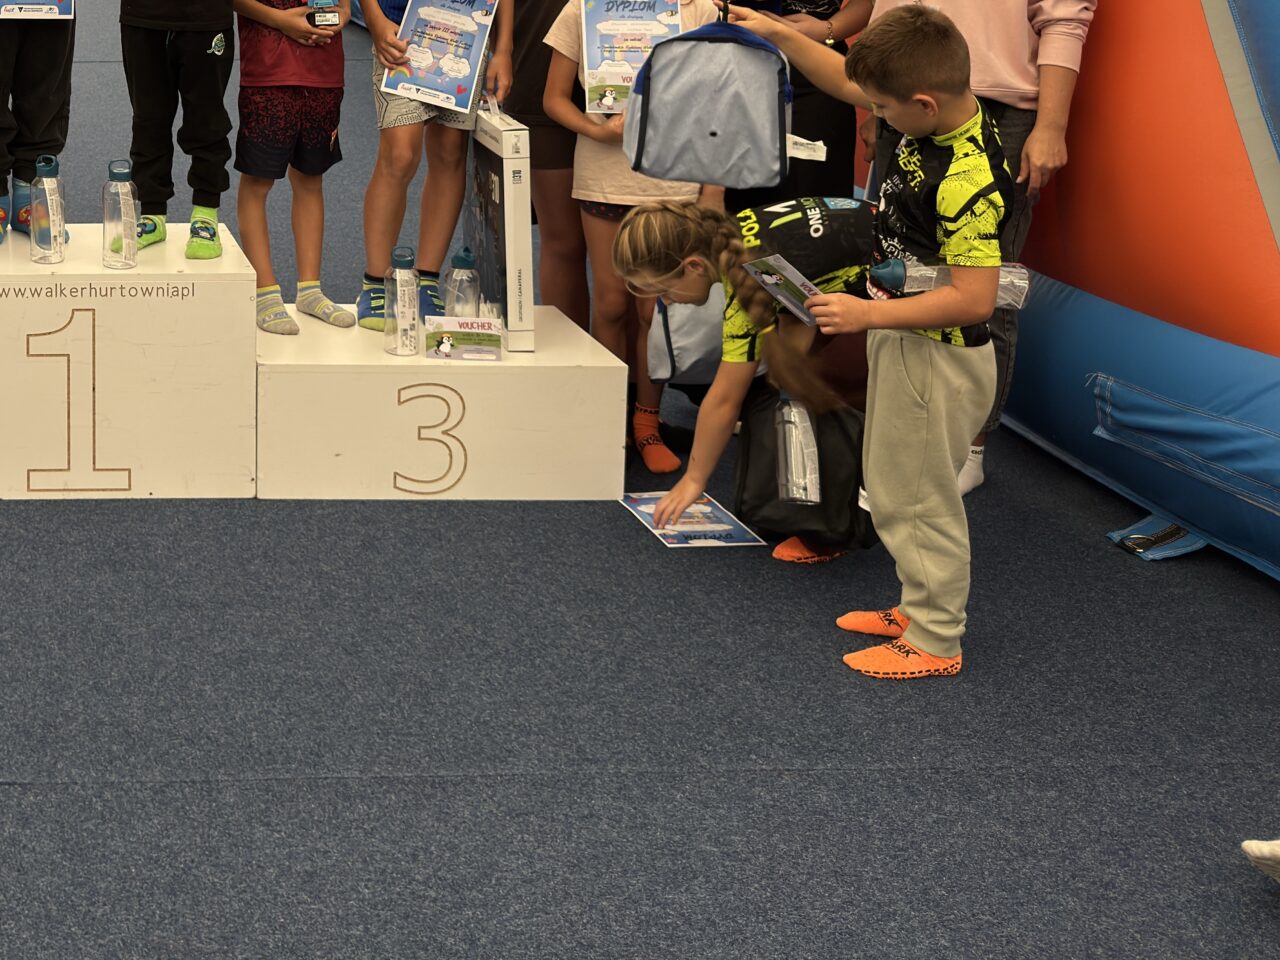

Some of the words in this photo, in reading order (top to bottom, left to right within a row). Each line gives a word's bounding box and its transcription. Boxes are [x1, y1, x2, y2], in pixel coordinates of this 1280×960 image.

[605, 0, 657, 13] DYPLOM
[458, 321, 493, 331] VOUCHER
[26, 308, 132, 492] 1
[393, 383, 468, 495] 3
[880, 611, 899, 627] RK
